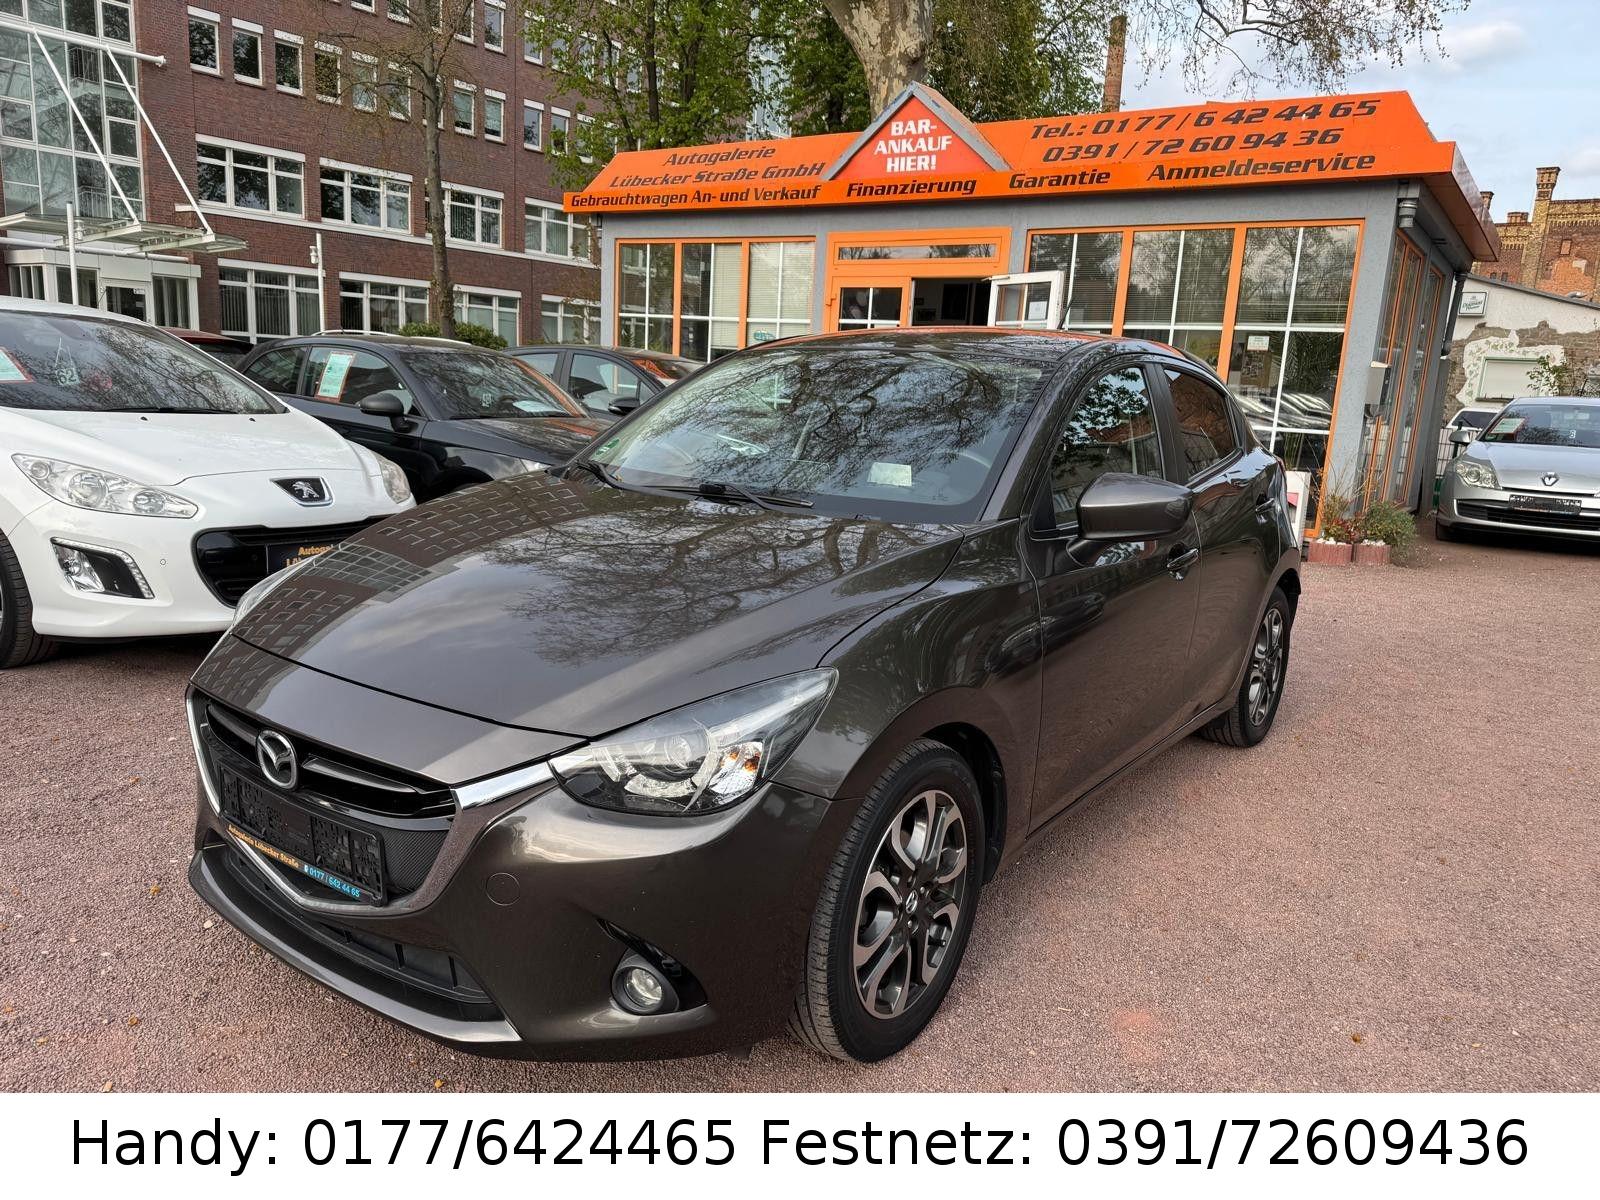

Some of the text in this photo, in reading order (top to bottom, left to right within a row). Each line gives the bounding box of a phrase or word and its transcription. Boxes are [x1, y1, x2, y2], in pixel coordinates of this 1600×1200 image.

[891, 118, 937, 136] BAR-
[1031, 122, 1087, 139] Tel.:
[1221, 107, 1269, 124] 42
[1274, 103, 1323, 121] 44
[1328, 100, 1381, 118] 65
[874, 135, 952, 155] ANKAUF
[1042, 142, 1119, 163] 0391
[1143, 138, 1184, 156] 72
[1189, 135, 1235, 152] 60
[1239, 131, 1288, 150] 94
[1293, 128, 1344, 146] 36
[663, 146, 775, 167] Autogalerie
[886, 154, 937, 173] HIER!
[1147, 152, 1376, 181] Anmeldeservice
[609, 162, 826, 188] Lübecker Straße GmbH
[1008, 168, 1111, 189] Garantie
[571, 185, 822, 207] Gebrauchtwagen An- und Verkauf
[847, 179, 977, 196] Finanzierung
[310, 867, 324, 880] 0177
